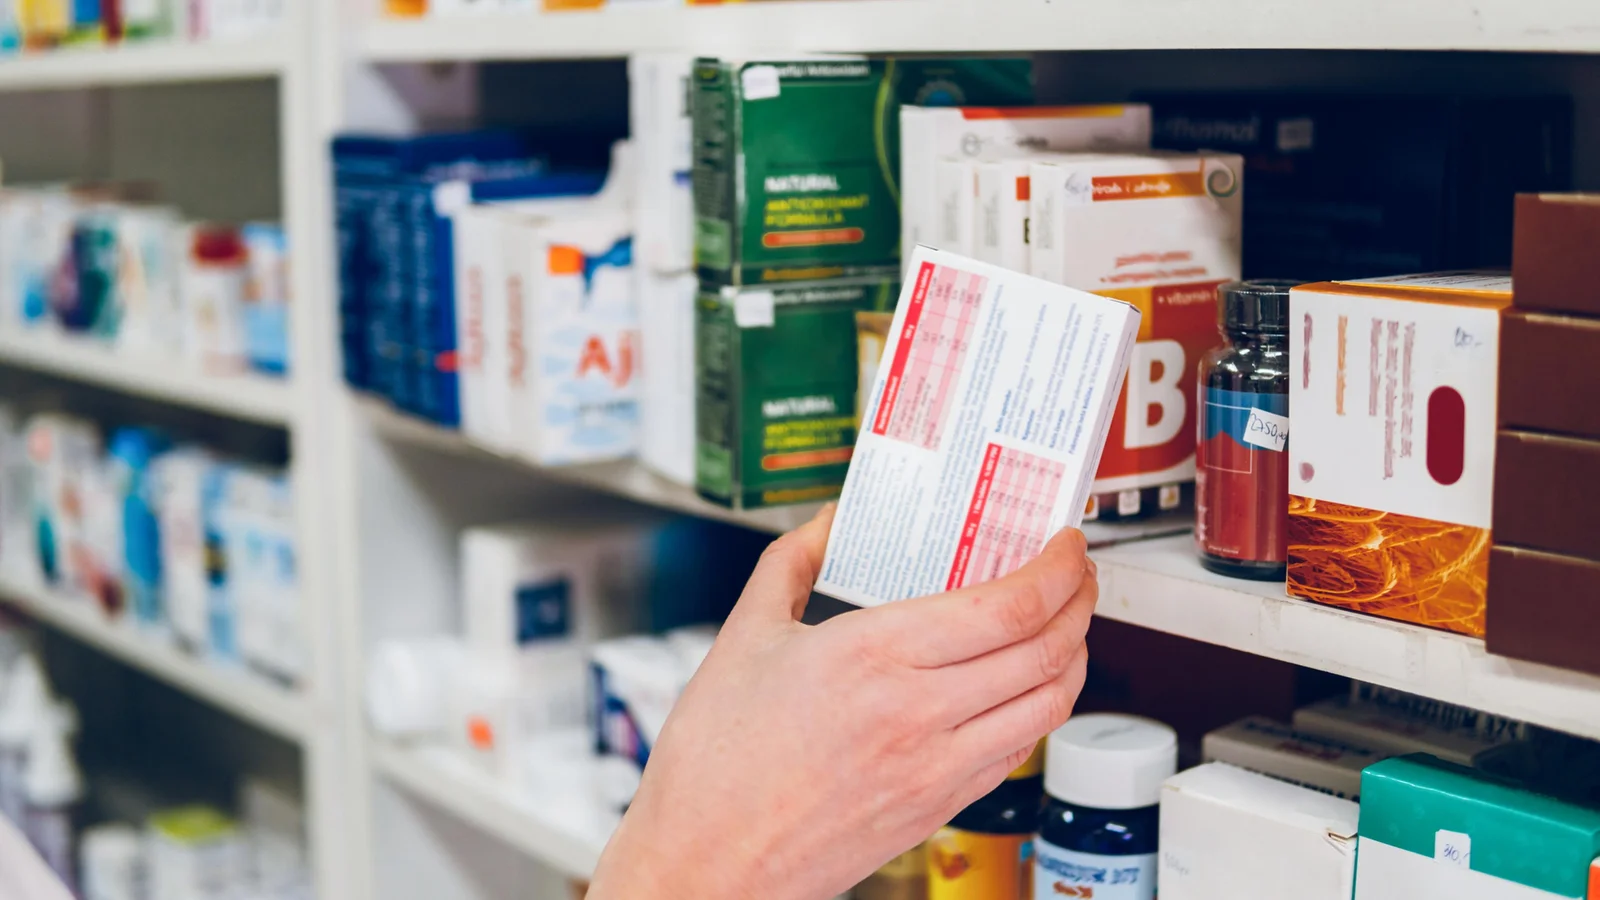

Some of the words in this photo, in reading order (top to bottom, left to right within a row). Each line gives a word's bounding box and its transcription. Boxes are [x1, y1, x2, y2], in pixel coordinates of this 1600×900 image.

[763, 173, 841, 192] NATURAL
[1124, 339, 1187, 449] B
[762, 395, 839, 417] NATURAL
